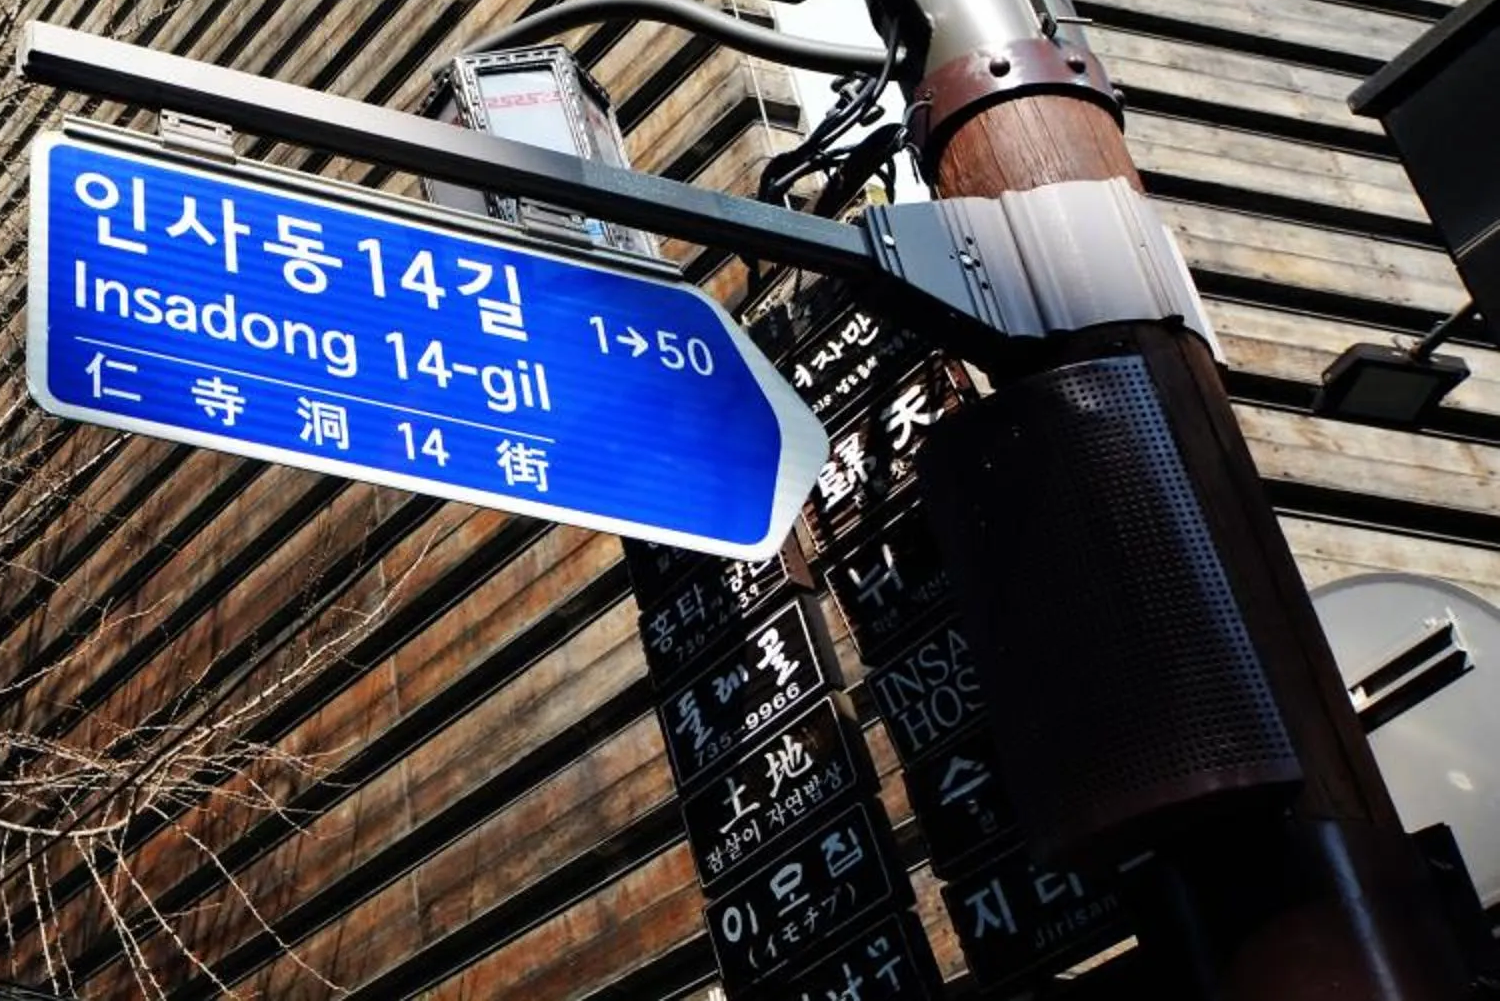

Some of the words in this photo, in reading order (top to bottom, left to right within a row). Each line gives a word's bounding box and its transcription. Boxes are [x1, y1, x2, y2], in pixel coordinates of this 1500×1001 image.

[74, 172, 528, 342] 인사동14길
[75, 260, 358, 378] Insadong
[385, 331, 552, 413] 14-gil
